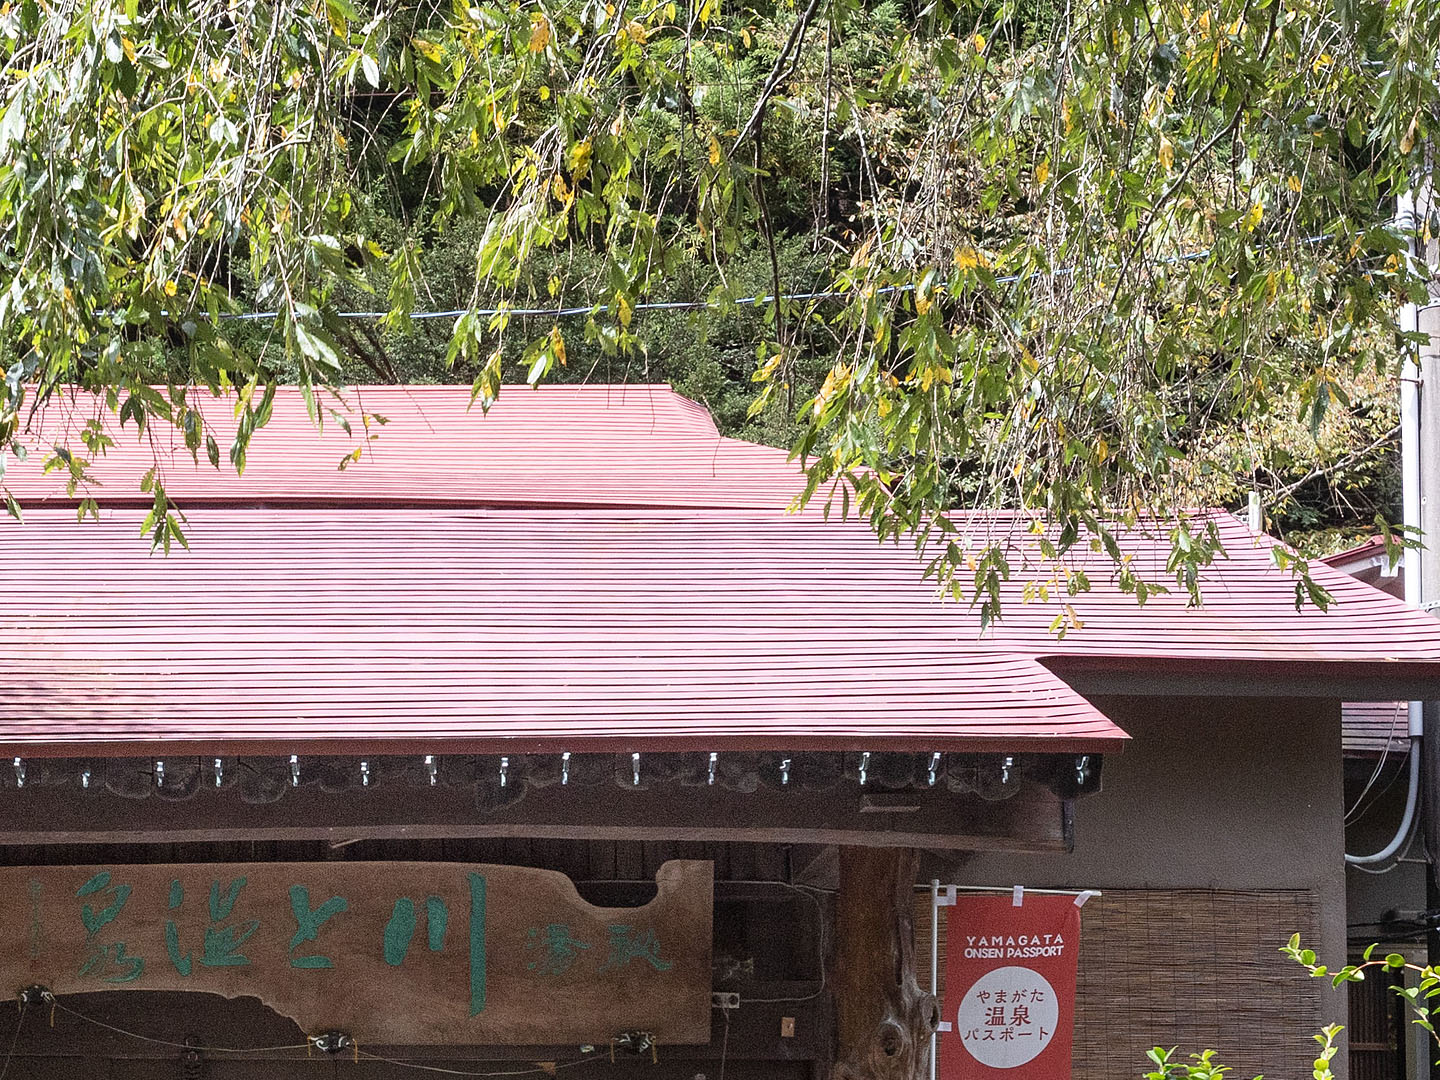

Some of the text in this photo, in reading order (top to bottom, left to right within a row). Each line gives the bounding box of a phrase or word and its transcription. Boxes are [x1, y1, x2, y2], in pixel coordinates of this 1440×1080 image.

[965, 933, 1065, 947] YAMAGATA
[964, 945, 1065, 959] ONSEN PASSPORT
[976, 988, 1046, 1004] やまがた
[984, 1004, 1033, 1028] 温泉
[964, 1028, 1050, 1042] パスポート
